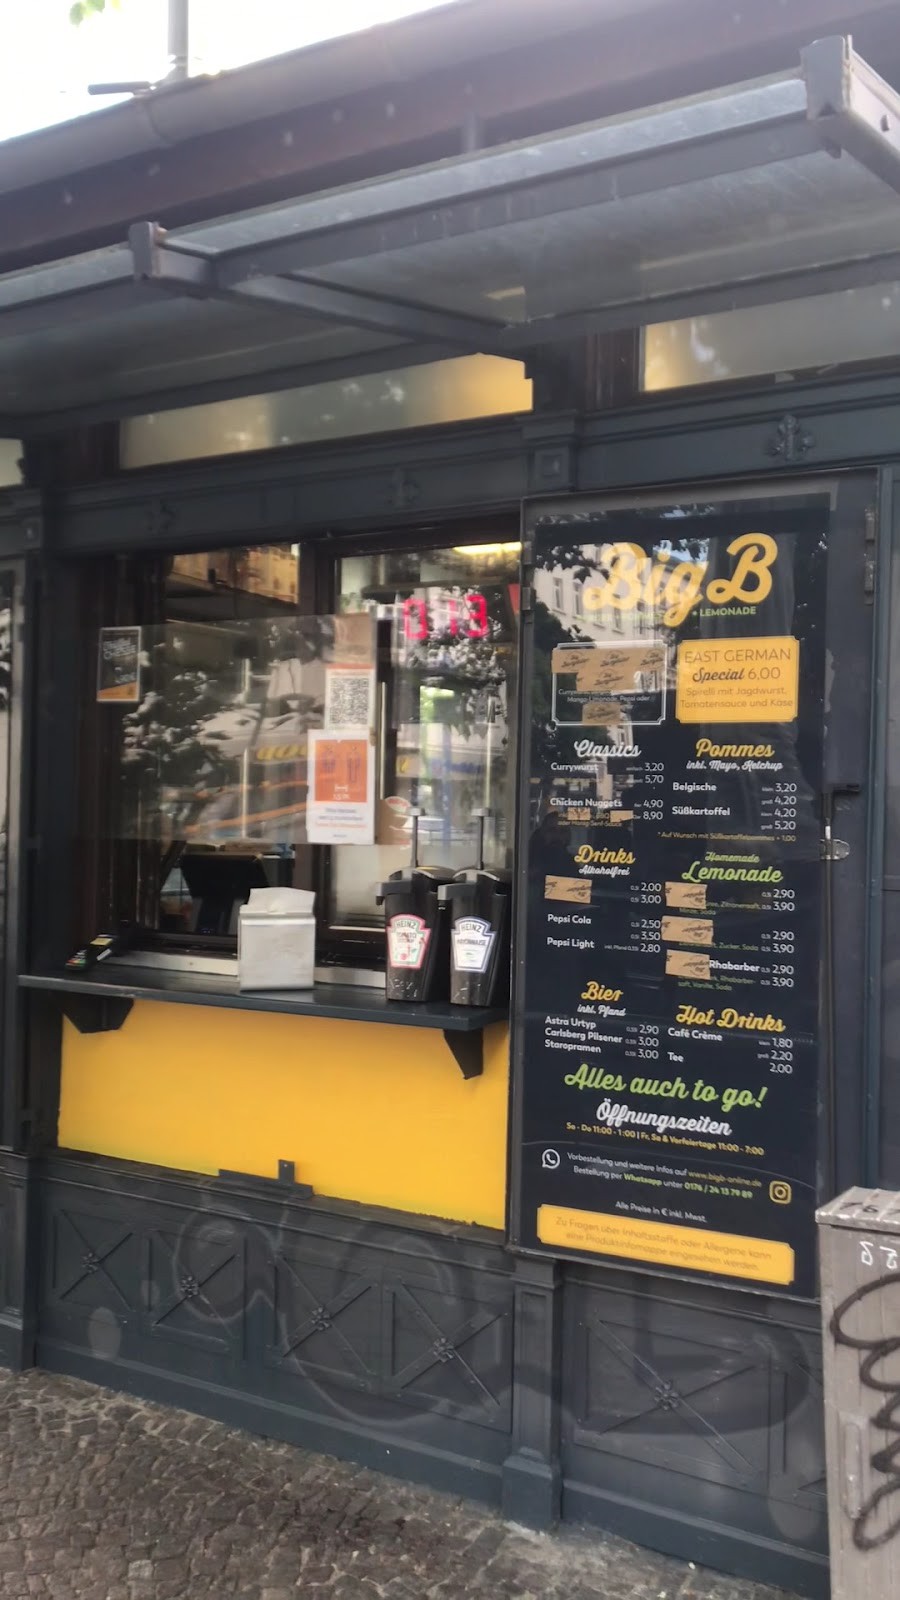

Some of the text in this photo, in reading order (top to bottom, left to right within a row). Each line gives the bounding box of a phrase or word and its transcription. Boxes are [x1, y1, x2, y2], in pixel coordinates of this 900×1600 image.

[583, 532, 777, 627] Big B
[700, 607, 757, 617] LEMONADE
[684, 648, 791, 664] EAST GERMAN
[692, 667, 745, 684] Special
[718, 687, 733, 695] mit
[681, 699, 747, 709] Tomatensauce
[750, 699, 768, 708] und
[574, 739, 642, 757] Classics
[695, 738, 775, 757] Pommes
[550, 762, 599, 772] Currywurst
[686, 760, 783, 772] inkl. Mayo, Ketchup
[672, 782, 717, 793] Belgische
[550, 797, 584, 806] Chicken
[585, 798, 623, 809] Nuggets
[672, 805, 731, 816] Süßkartoffel
[574, 844, 636, 864] Drinks
[705, 851, 760, 863] Homemade
[578, 864, 631, 878] Alkoholfrei
[681, 861, 784, 882] Lemonade
[396, 920, 417, 930] HEINZ
[547, 913, 571, 924] Pepsi
[572, 915, 592, 924] Cola
[460, 923, 482, 933] HEINZ
[547, 937, 570, 948] Pepsi
[571, 939, 595, 950] Light
[709, 959, 760, 972] Rhabarber
[581, 980, 624, 1001] Bier
[715, 983, 732, 991] Soda
[577, 1004, 626, 1018] inkl. Pfand
[675, 1004, 786, 1032] Hot Drinks
[545, 1016, 569, 1026] Astra
[570, 1018, 596, 1030] Urtyp
[545, 1028, 586, 1041] Carlsberg
[587, 1032, 623, 1043] Pilsener
[667, 1026, 723, 1041] Café Crème
[545, 1040, 602, 1053] Staropramen
[667, 1051, 684, 1062] Tee
[564, 1063, 769, 1113] Alles auch to go!
[596, 1097, 733, 1137] Öffnungszeiten
[581, 1124, 592, 1132] Do
[592, 1125, 613, 1135] 11:00
[662, 1134, 669, 1143] &
[567, 1152, 613, 1167] Vorbestellung
[614, 1160, 628, 1168] und
[629, 1162, 655, 1172] weitere
[656, 1164, 673, 1175] Infos
[674, 1168, 688, 1176] auf
[573, 1165, 610, 1179] Bestellung
[663, 1180, 683, 1189] unter
[615, 1201, 629, 1210] Alle
[629, 1202, 652, 1214] Preise
[652, 1206, 660, 1215] in
[661, 1207, 668, 1216] €
[556, 1216, 567, 1226] Zu
[569, 1219, 599, 1231] Fragen
[680, 1239, 701, 1248] oder
[704, 1241, 746, 1256] Allergene
[748, 1249, 772, 1259] kann
